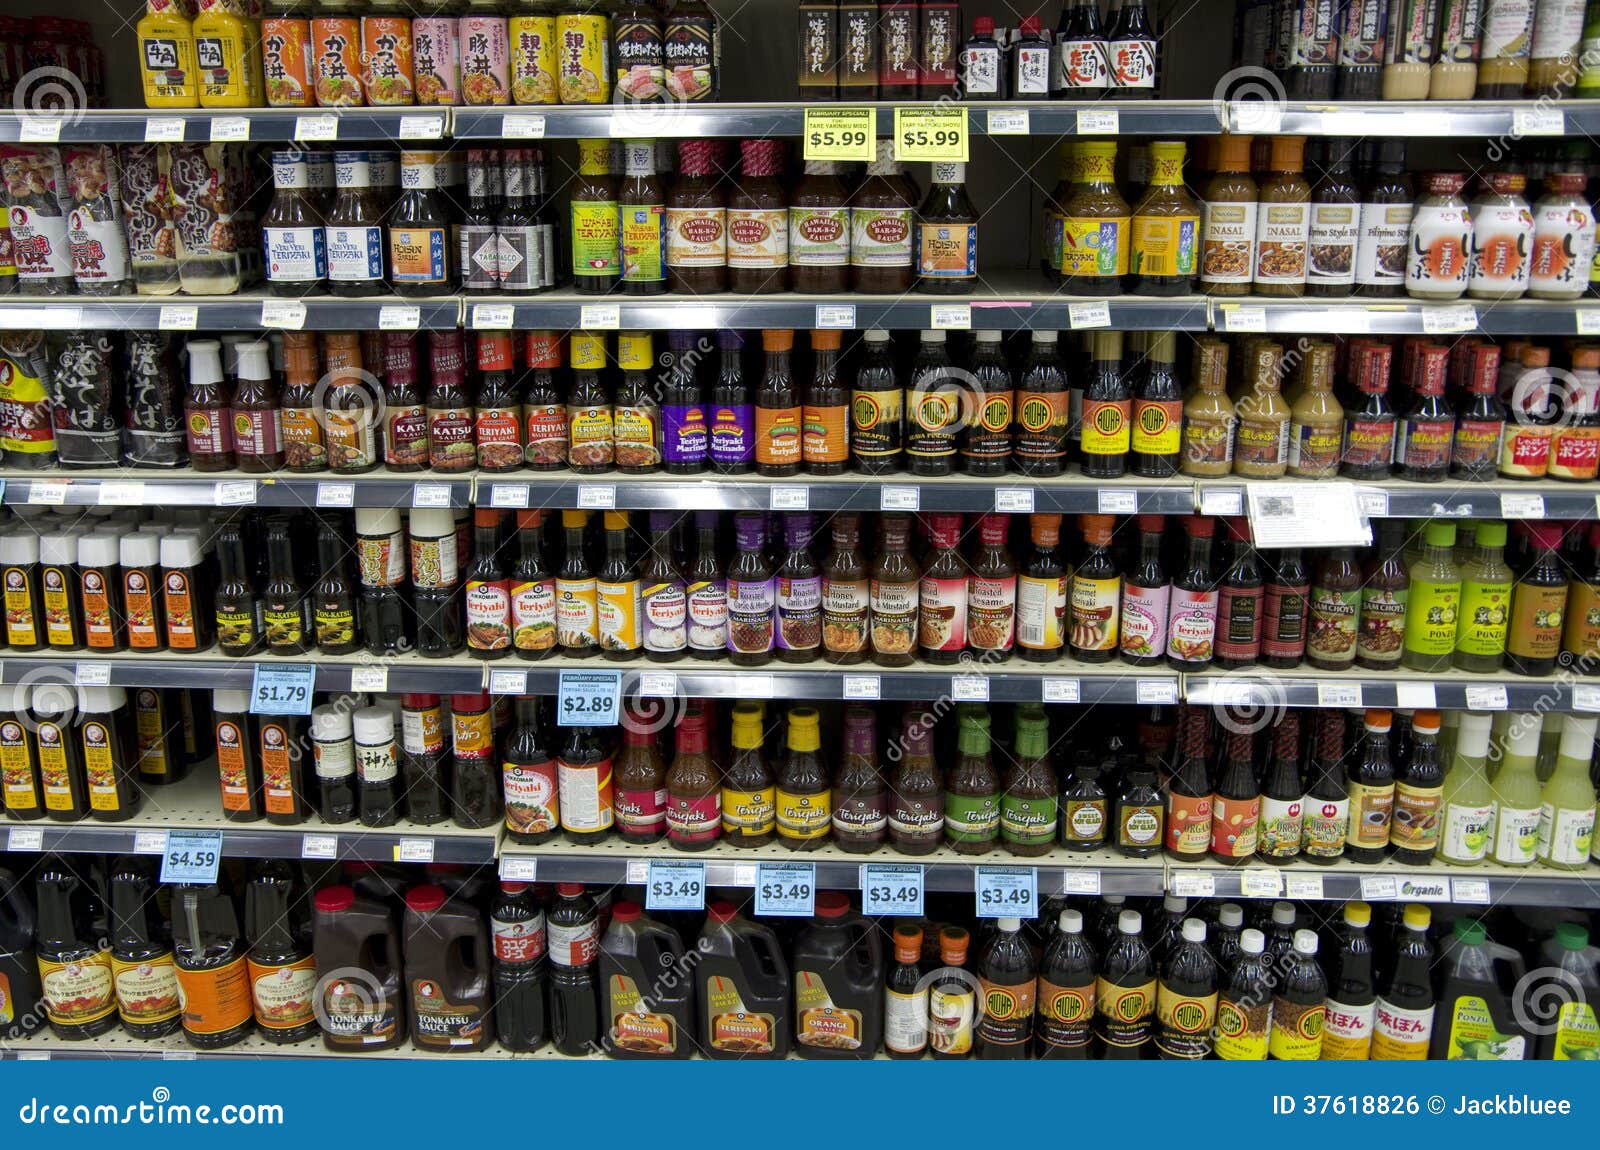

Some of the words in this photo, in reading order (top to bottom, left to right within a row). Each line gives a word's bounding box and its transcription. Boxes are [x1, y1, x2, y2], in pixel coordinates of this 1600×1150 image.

[810, 131, 866, 148] $5.99
[903, 131, 960, 148] $5.99
[690, 233, 715, 242] SAUCE
[808, 233, 834, 242] SAUCE
[875, 233, 901, 242] SAUCE
[396, 422, 427, 432] KATS
[433, 426, 472, 435] KATSU
[479, 426, 515, 435] TERIYAKI
[830, 593, 853, 602] Honey
[880, 593, 904, 602] Honey
[258, 685, 306, 703] $1.79
[564, 696, 613, 714] $2.89
[839, 808, 881, 825] Teriyaki
[896, 809, 938, 826] Teriyaki
[169, 851, 215, 869] $4.59
[652, 880, 700, 900] $3.49
[762, 883, 810, 902] $3.49
[870, 886, 918, 904] $3.49
[982, 888, 1030, 906] $3.49
[329, 1013, 382, 1024] TONKATSU
[418, 1013, 469, 1024] TONKATSU
[1377, 1009, 1425, 1034] 味ぽん
[1457, 1011, 1489, 1024] PONZU
[330, 1023, 363, 1031] SAUCE
[419, 1023, 449, 1032] SAUCE
[809, 1019, 847, 1029] ORANGE
